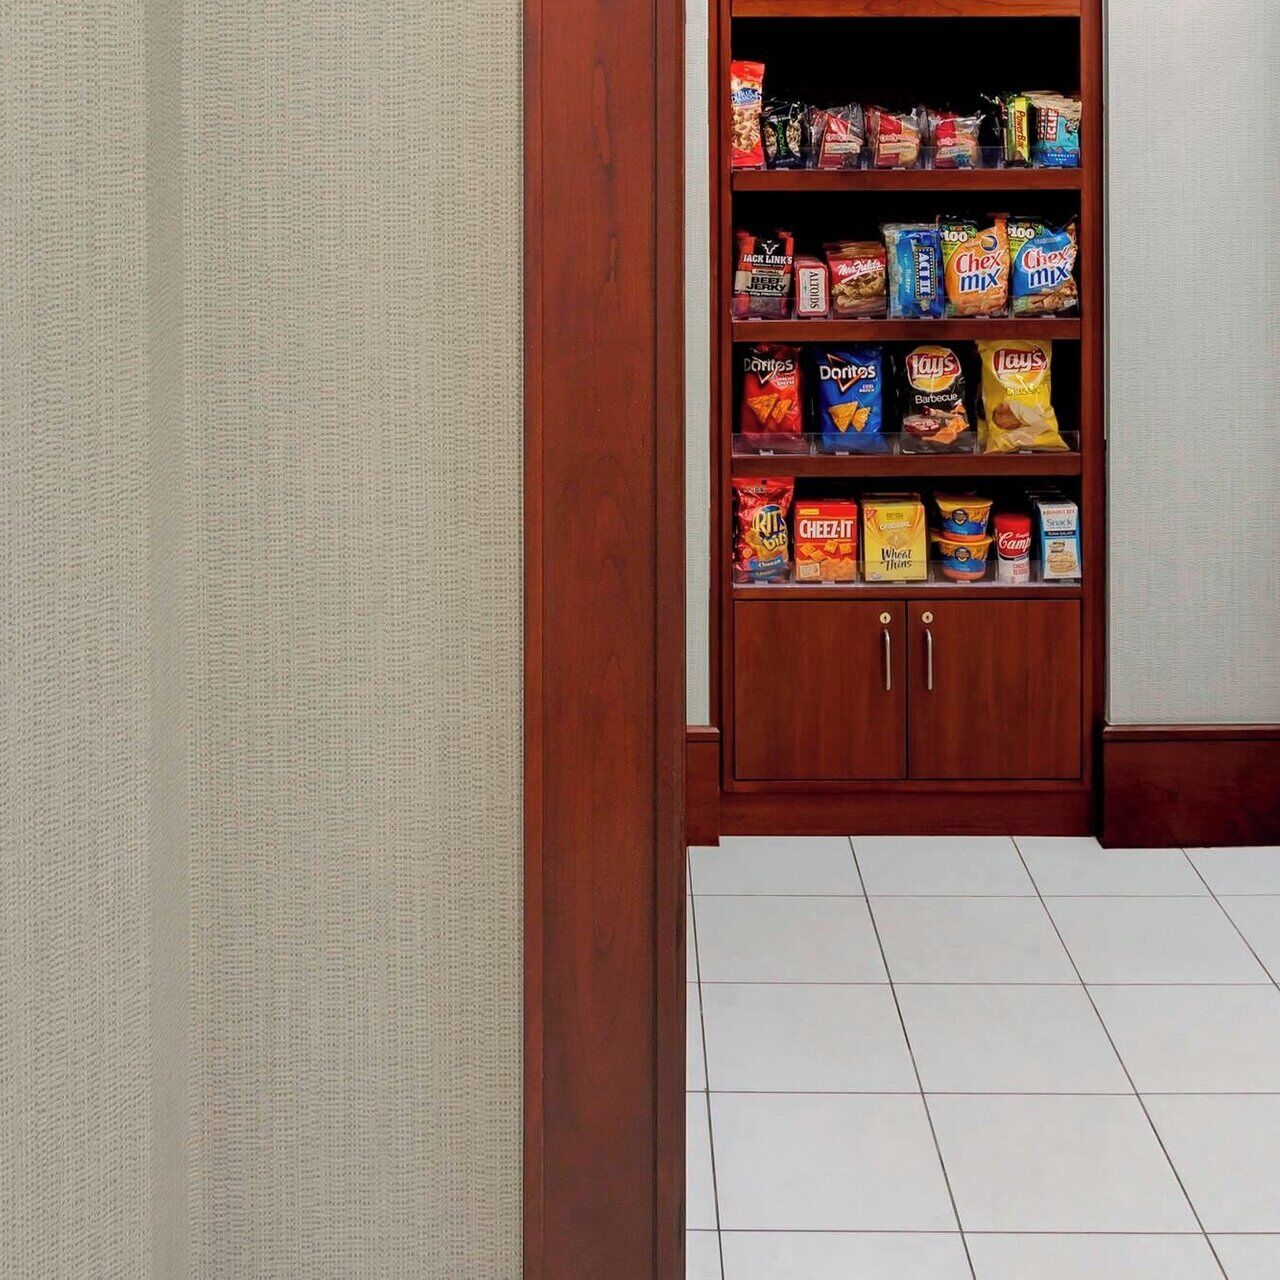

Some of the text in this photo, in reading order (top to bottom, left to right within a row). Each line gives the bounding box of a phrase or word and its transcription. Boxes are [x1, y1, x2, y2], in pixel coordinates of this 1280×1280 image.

[743, 255, 793, 265] JACK LINK'S
[955, 251, 1001, 274] Chex
[1023, 246, 1070, 270] Chex
[751, 276, 783, 284] BEEF
[960, 268, 1000, 291] mix
[1029, 260, 1069, 287] mix
[746, 283, 787, 292] JERKY
[809, 271, 820, 309] ALTOIDS
[743, 358, 794, 372] Doritos
[912, 355, 955, 377] Lay's
[998, 349, 1044, 373] Lay's
[820, 365, 876, 380] Doritos
[915, 393, 959, 404] Barbecue
[799, 519, 854, 538] CHEEZ-IT
[881, 548, 911, 560] Wheat
[880, 560, 912, 571] Thins
